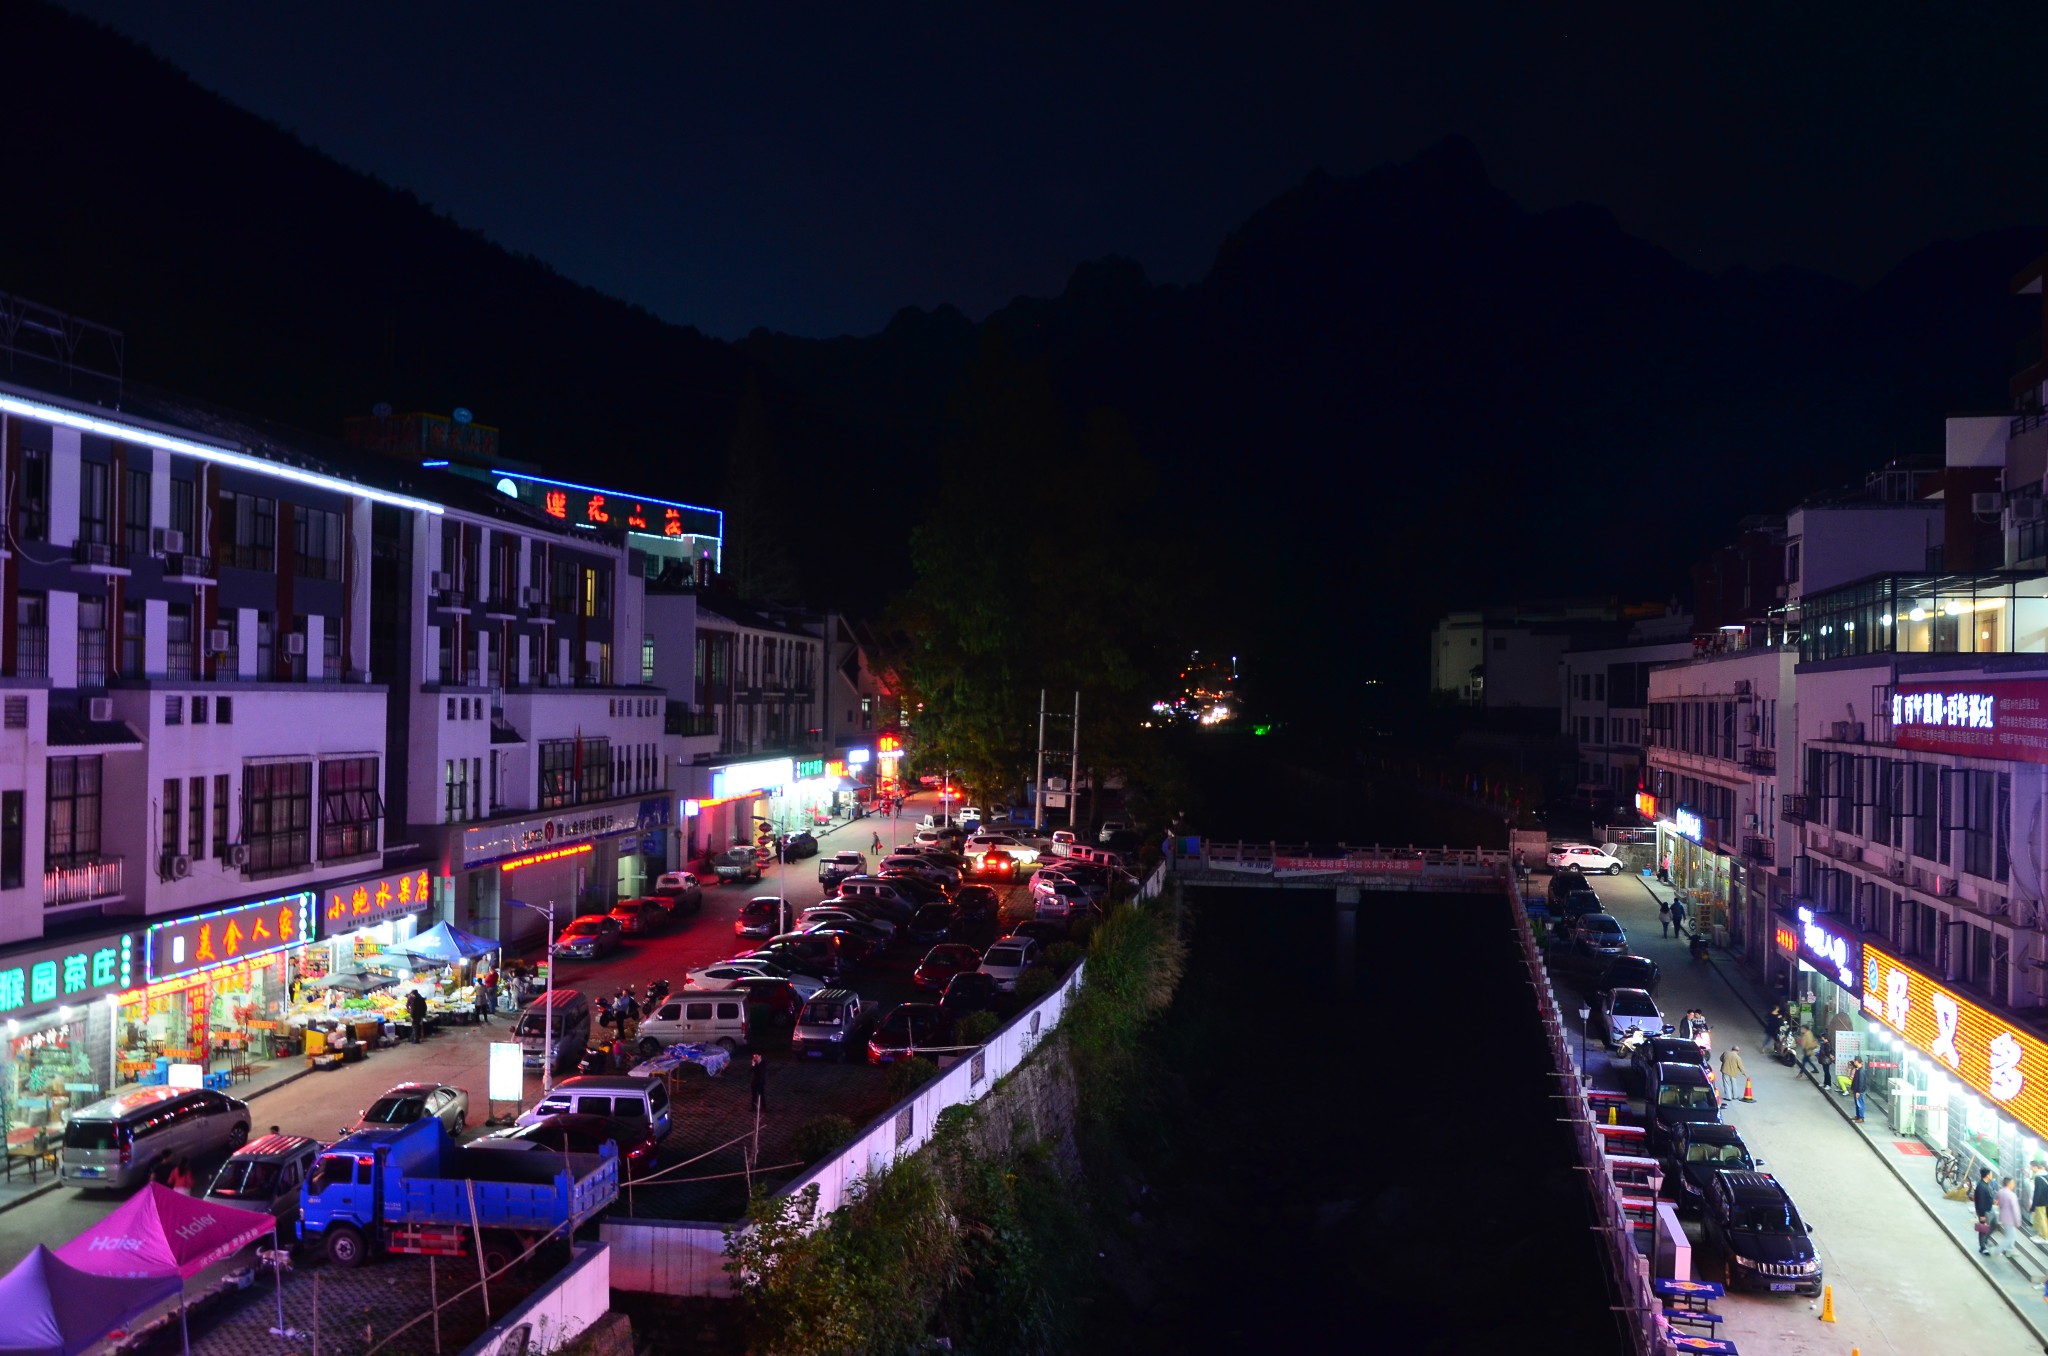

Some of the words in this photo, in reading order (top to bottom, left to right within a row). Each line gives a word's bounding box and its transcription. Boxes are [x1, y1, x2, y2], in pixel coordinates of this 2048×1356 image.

[195, 905, 294, 963] 美食人家
[175, 1213, 217, 1240] Haier
[88, 1234, 145, 1251] Haier
